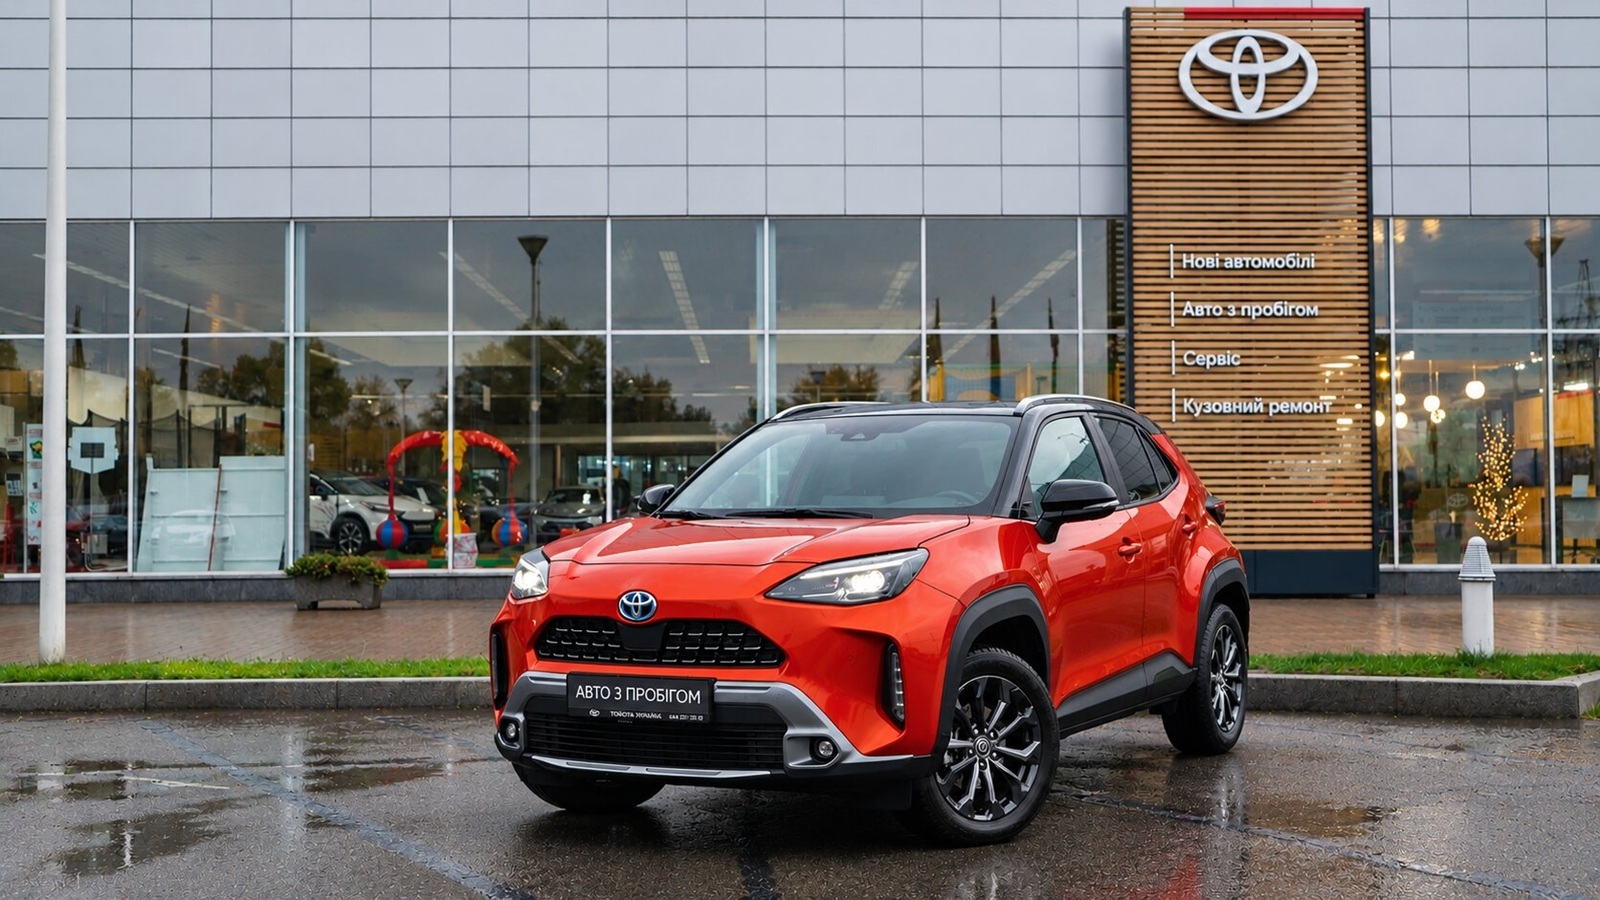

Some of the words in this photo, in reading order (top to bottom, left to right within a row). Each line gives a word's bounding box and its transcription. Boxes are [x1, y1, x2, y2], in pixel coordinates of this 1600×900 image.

[1182, 253, 1219, 268] Нові
[1224, 253, 1315, 268] автомобілі
[1182, 301, 1223, 316] Авто
[1227, 305, 1236, 316] з
[1241, 301, 1318, 320] пробігом
[1183, 350, 1241, 369] Сервіс
[1183, 397, 1263, 417] Кузовний
[1269, 401, 1332, 416] ремонт
[576, 685, 611, 700] АВТО
[626, 687, 701, 704] ПРОБІГОМ
